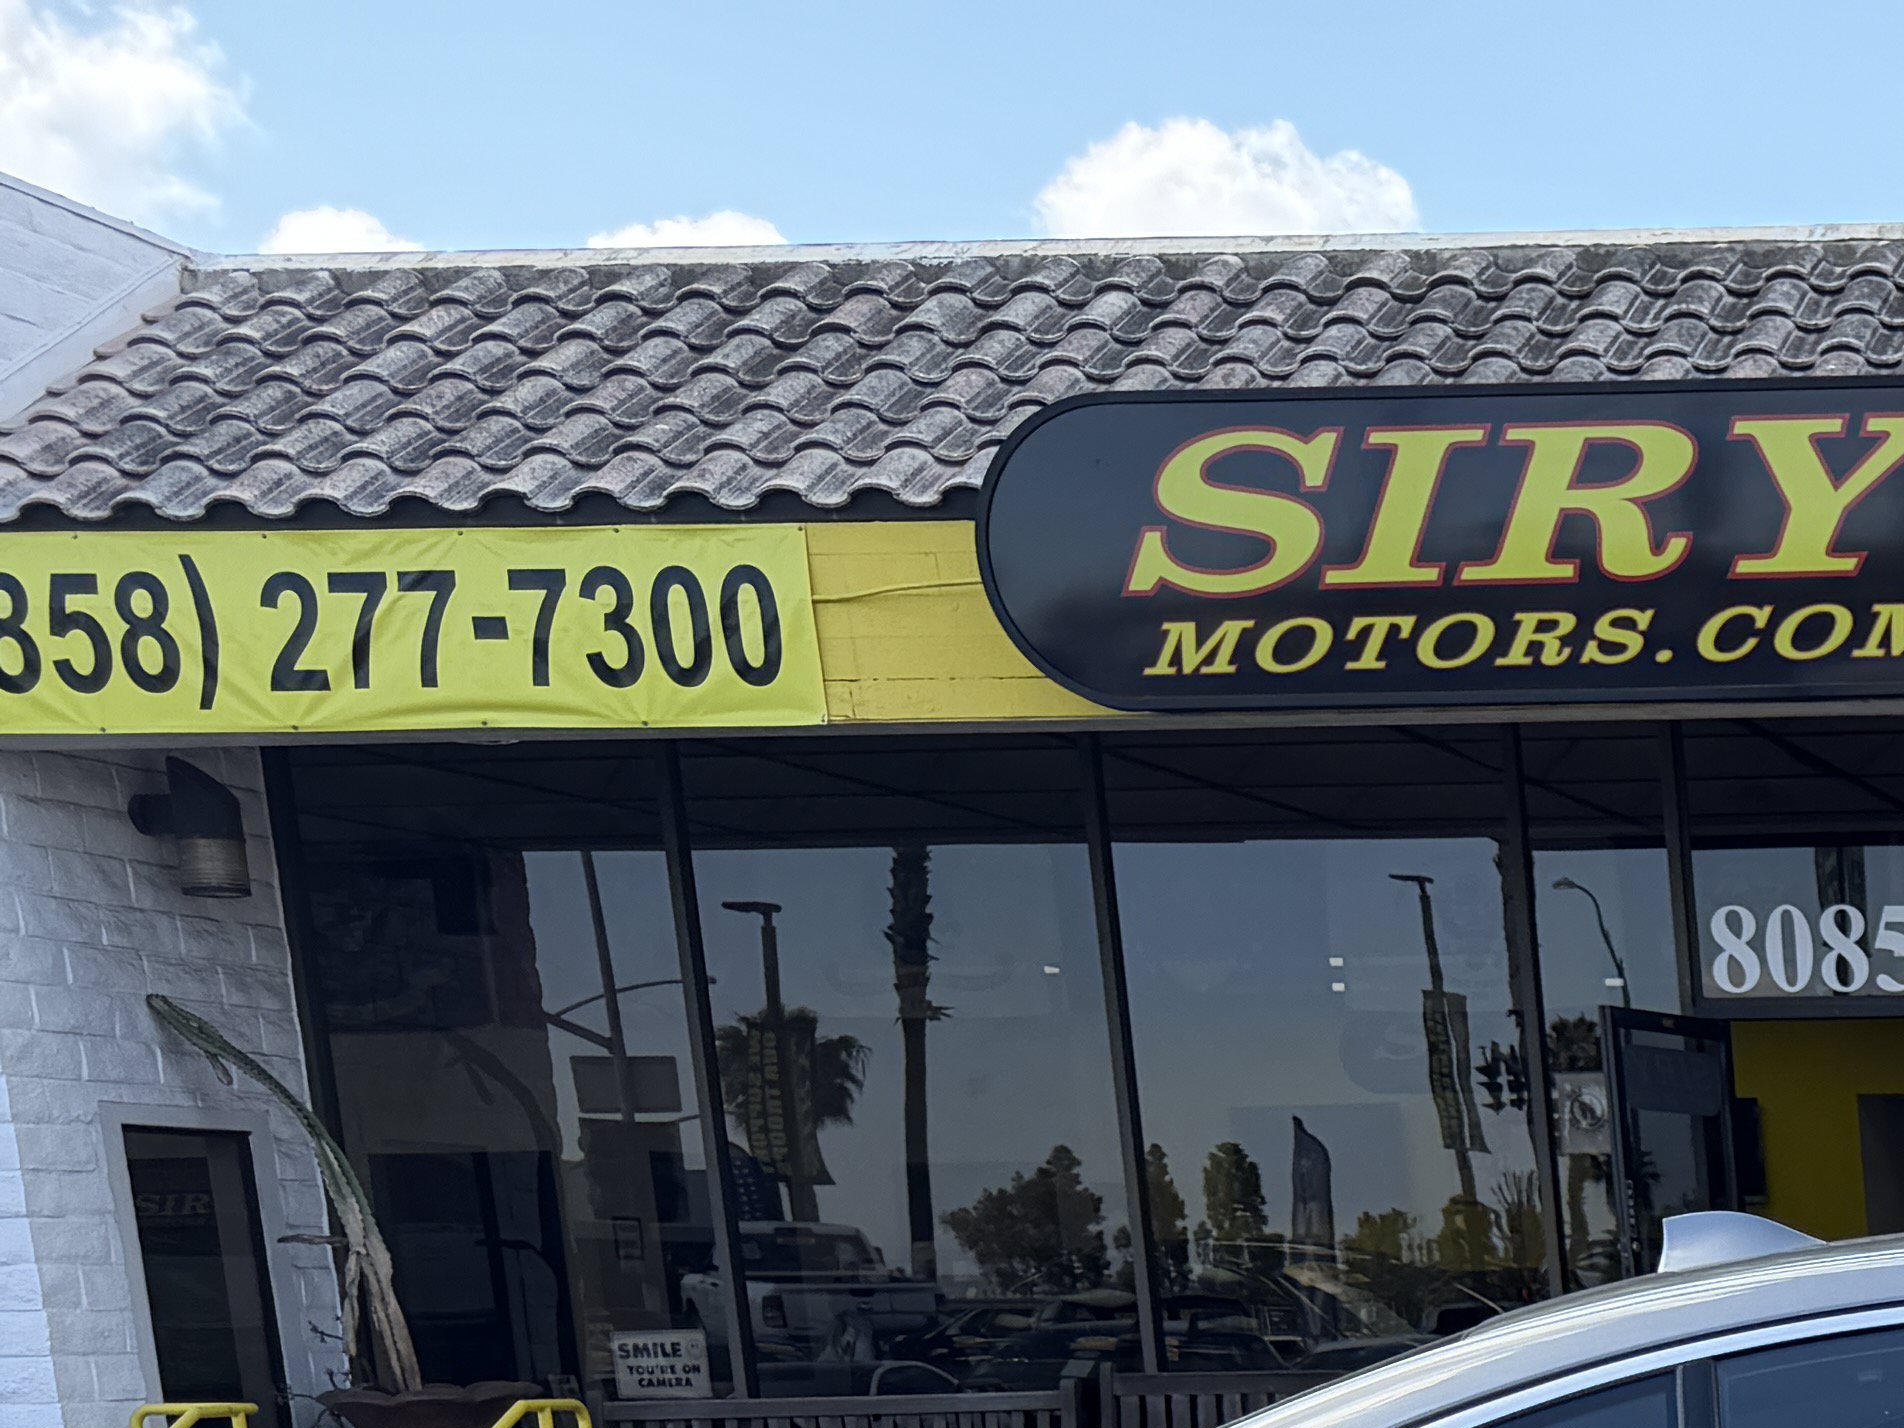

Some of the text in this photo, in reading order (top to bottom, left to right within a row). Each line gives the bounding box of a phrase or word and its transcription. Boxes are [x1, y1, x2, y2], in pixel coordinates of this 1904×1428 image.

[259, 563, 781, 694] 277-7300
[618, 1341, 682, 1359] SMILE
[627, 1364, 701, 1375] YOU'RE ON
[638, 1377, 693, 1388] CAMERA
